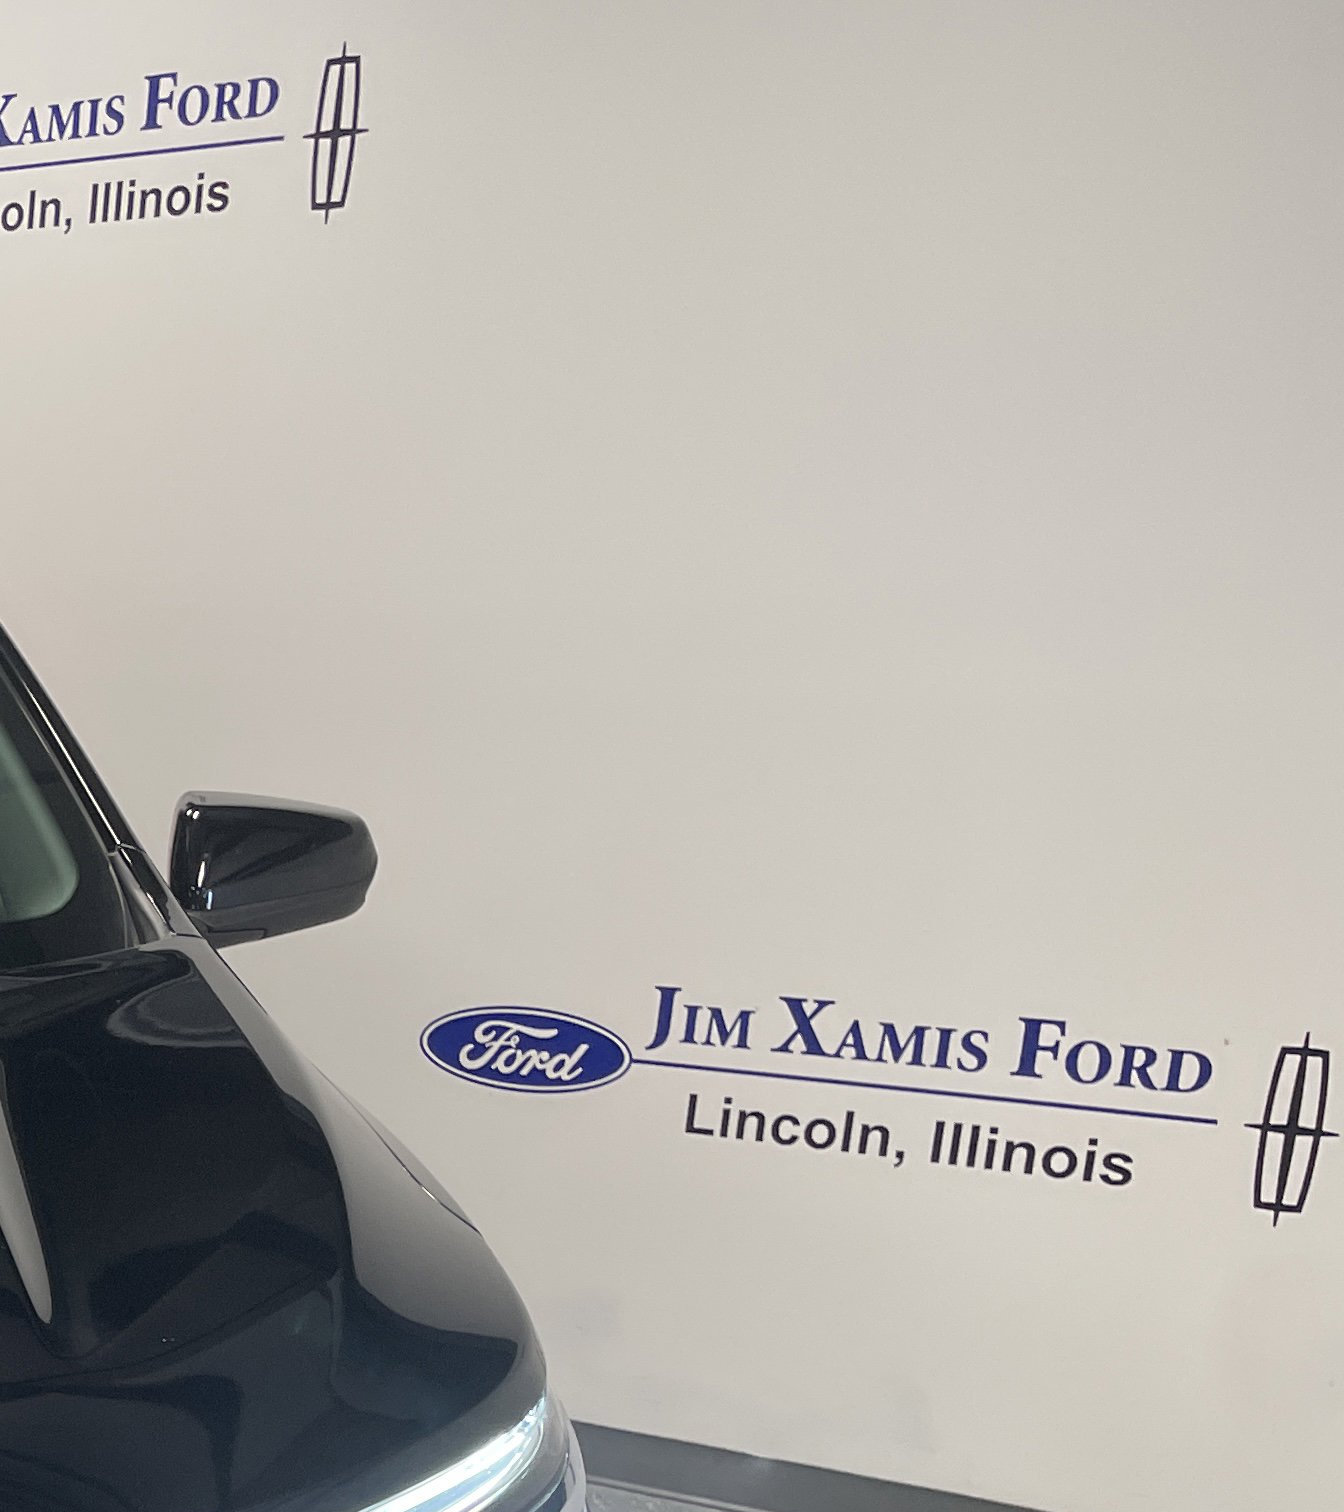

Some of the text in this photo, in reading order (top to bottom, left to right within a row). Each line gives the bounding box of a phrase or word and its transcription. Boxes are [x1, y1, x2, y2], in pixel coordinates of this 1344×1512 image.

[140, 72, 280, 131] FORD
[88, 172, 231, 223] Illinois
[458, 1019, 585, 1082] Ford
[645, 985, 1214, 1096] JIM XAMIS FORD
[683, 1093, 1135, 1188] Lincoln, Illinois
